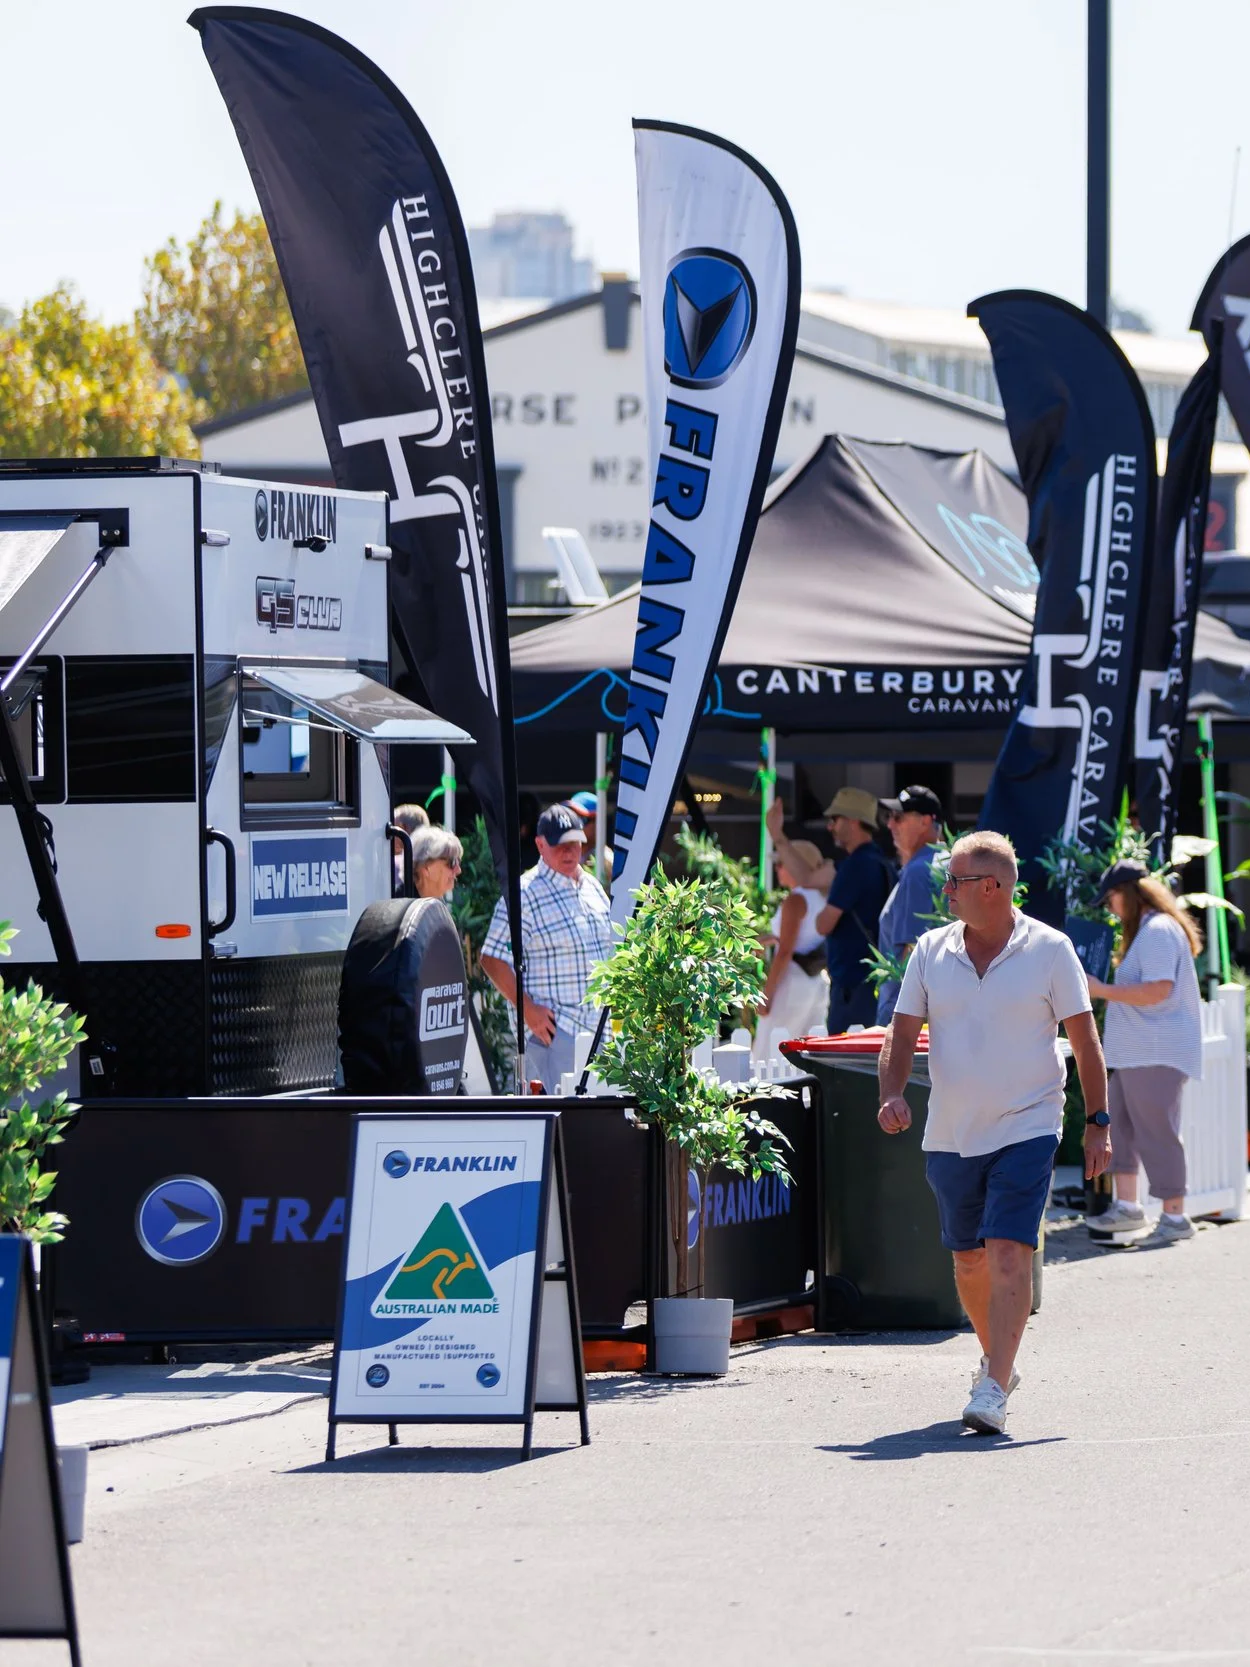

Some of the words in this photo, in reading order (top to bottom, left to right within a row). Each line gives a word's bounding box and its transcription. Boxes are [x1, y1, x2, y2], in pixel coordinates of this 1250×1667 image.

[402, 193, 477, 460] HIGHCLERE
[492, 393, 578, 426] RSE
[270, 490, 336, 543] FRANKLIN
[1097, 453, 1137, 686] HIGHCLERE
[611, 398, 719, 883] FRANKL
[736, 669, 1023, 695] CANTERBURY
[1070, 705, 1114, 857] CARAV
[254, 864, 287, 900] NEW
[288, 860, 347, 898] RELEASE
[412, 1155, 518, 1173] FRANKLIN
[705, 1175, 791, 1227] FRANKLIN
[375, 1303, 455, 1315] AUSTRALIAN
[460, 1302, 500, 1315] MADE
[395, 1343, 426, 1351] OWNED
[434, 1343, 477, 1351] DESIGNED
[417, 1334, 455, 1342] LOCALLY
[373, 1352, 441, 1361] MANUFACTURED
